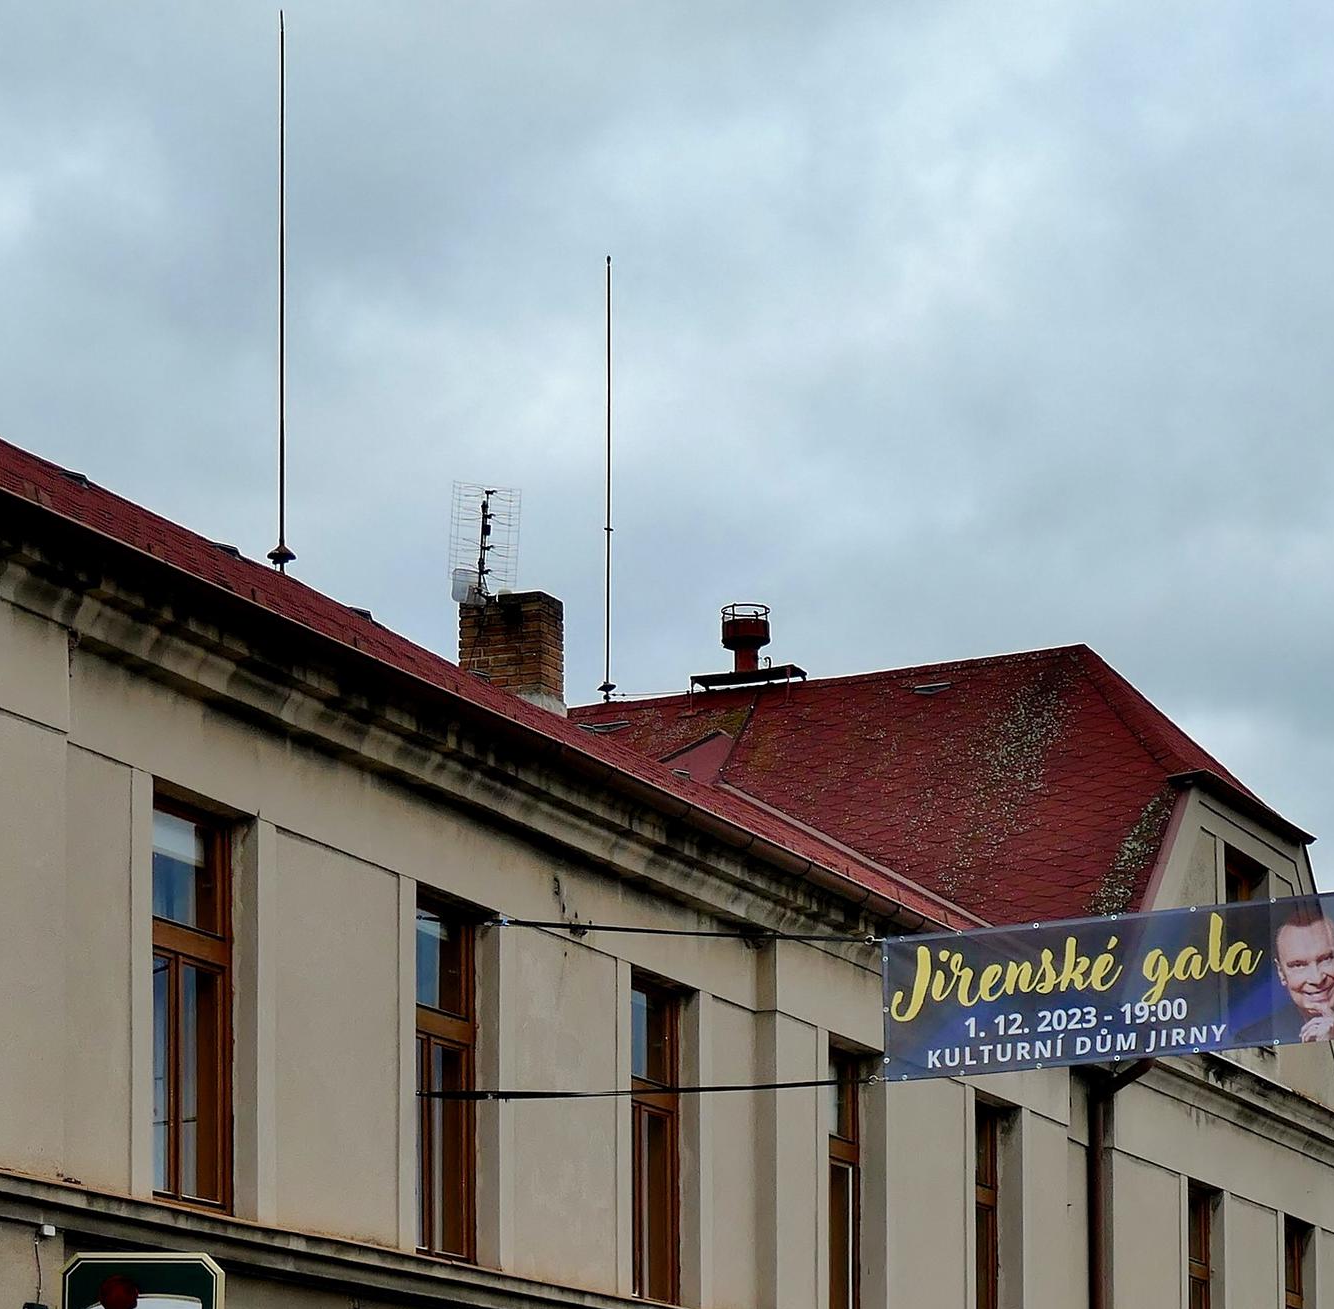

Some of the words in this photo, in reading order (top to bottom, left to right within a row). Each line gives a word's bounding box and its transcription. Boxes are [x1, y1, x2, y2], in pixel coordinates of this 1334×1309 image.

[890, 936, 1123, 1022] Jirenské
[1141, 912, 1263, 1005] gala
[964, 1016, 986, 1038] 1.
[994, 1013, 1030, 1036] 12.
[1037, 1006, 1097, 1032] 2023
[1120, 998, 1187, 1025] 19:00
[927, 1033, 1064, 1069] KULTURNÍ
[1075, 1028, 1137, 1055] DŮM
[1146, 1024, 1227, 1053] JIRNY
